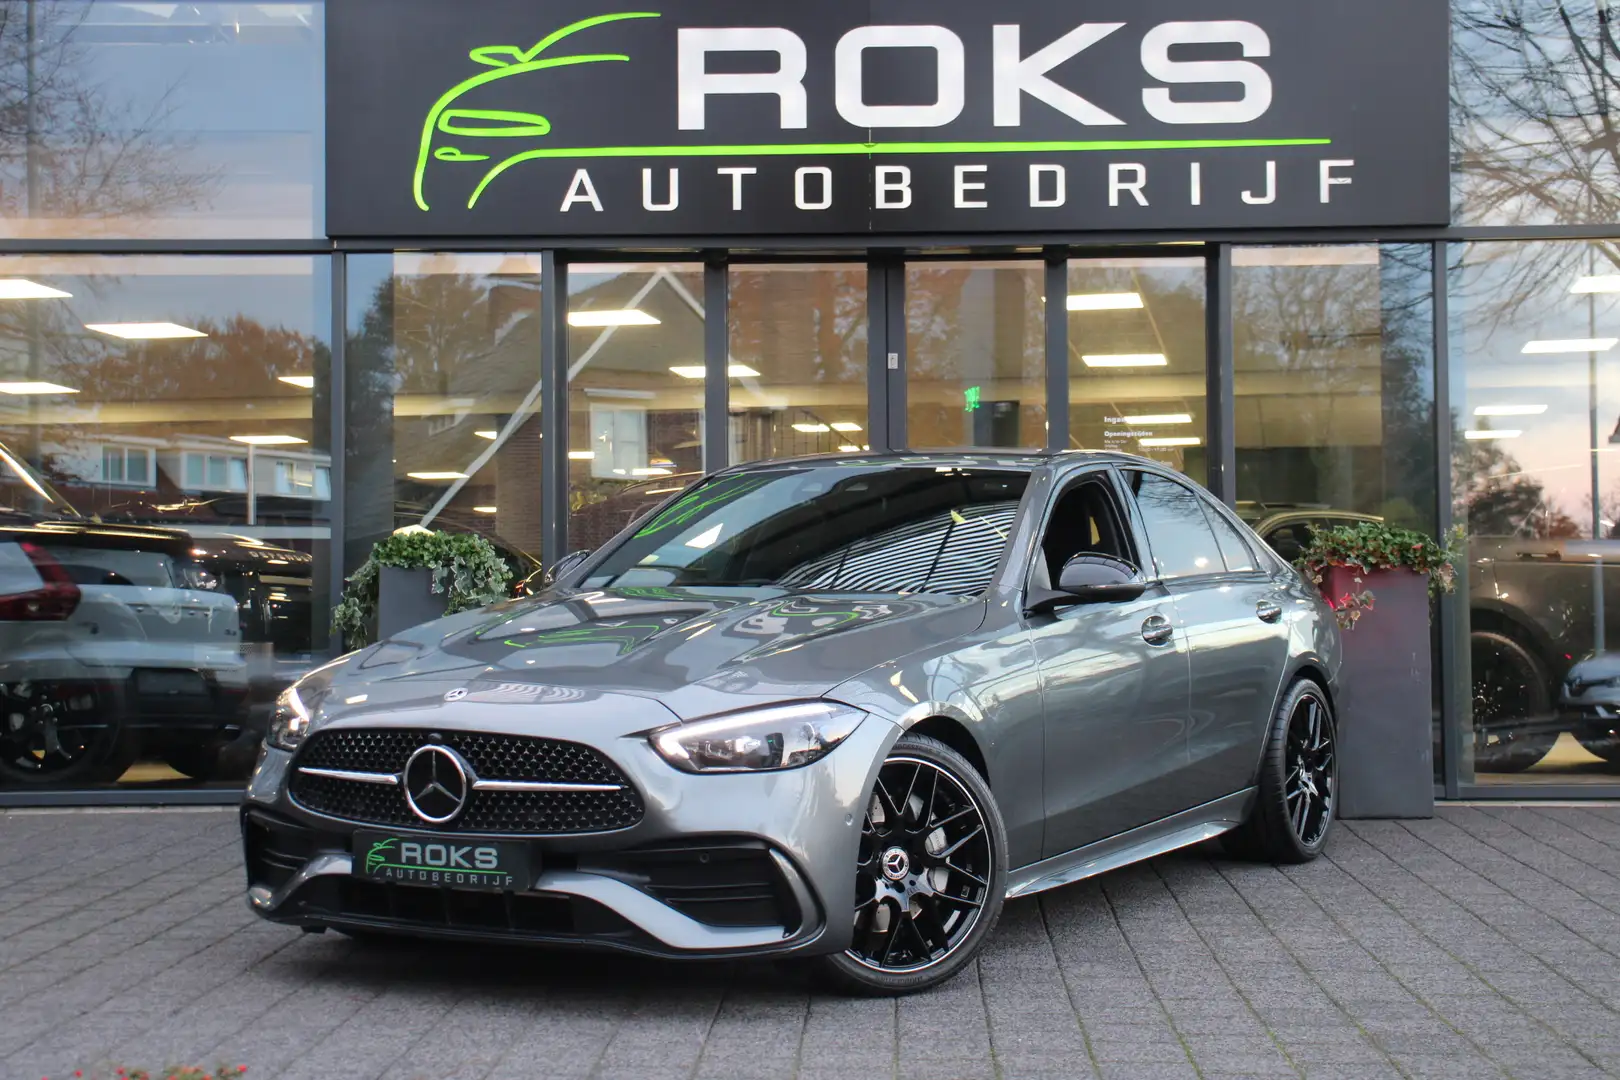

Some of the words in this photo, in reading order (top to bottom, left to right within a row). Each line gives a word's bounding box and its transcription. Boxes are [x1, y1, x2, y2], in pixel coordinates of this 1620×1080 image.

[677, 20, 1273, 131] ROKS
[559, 159, 1355, 213] AUTOBEDRIJF
[400, 842, 499, 869] ROKS
[385, 867, 513, 886] AUTOBEDRIJF
